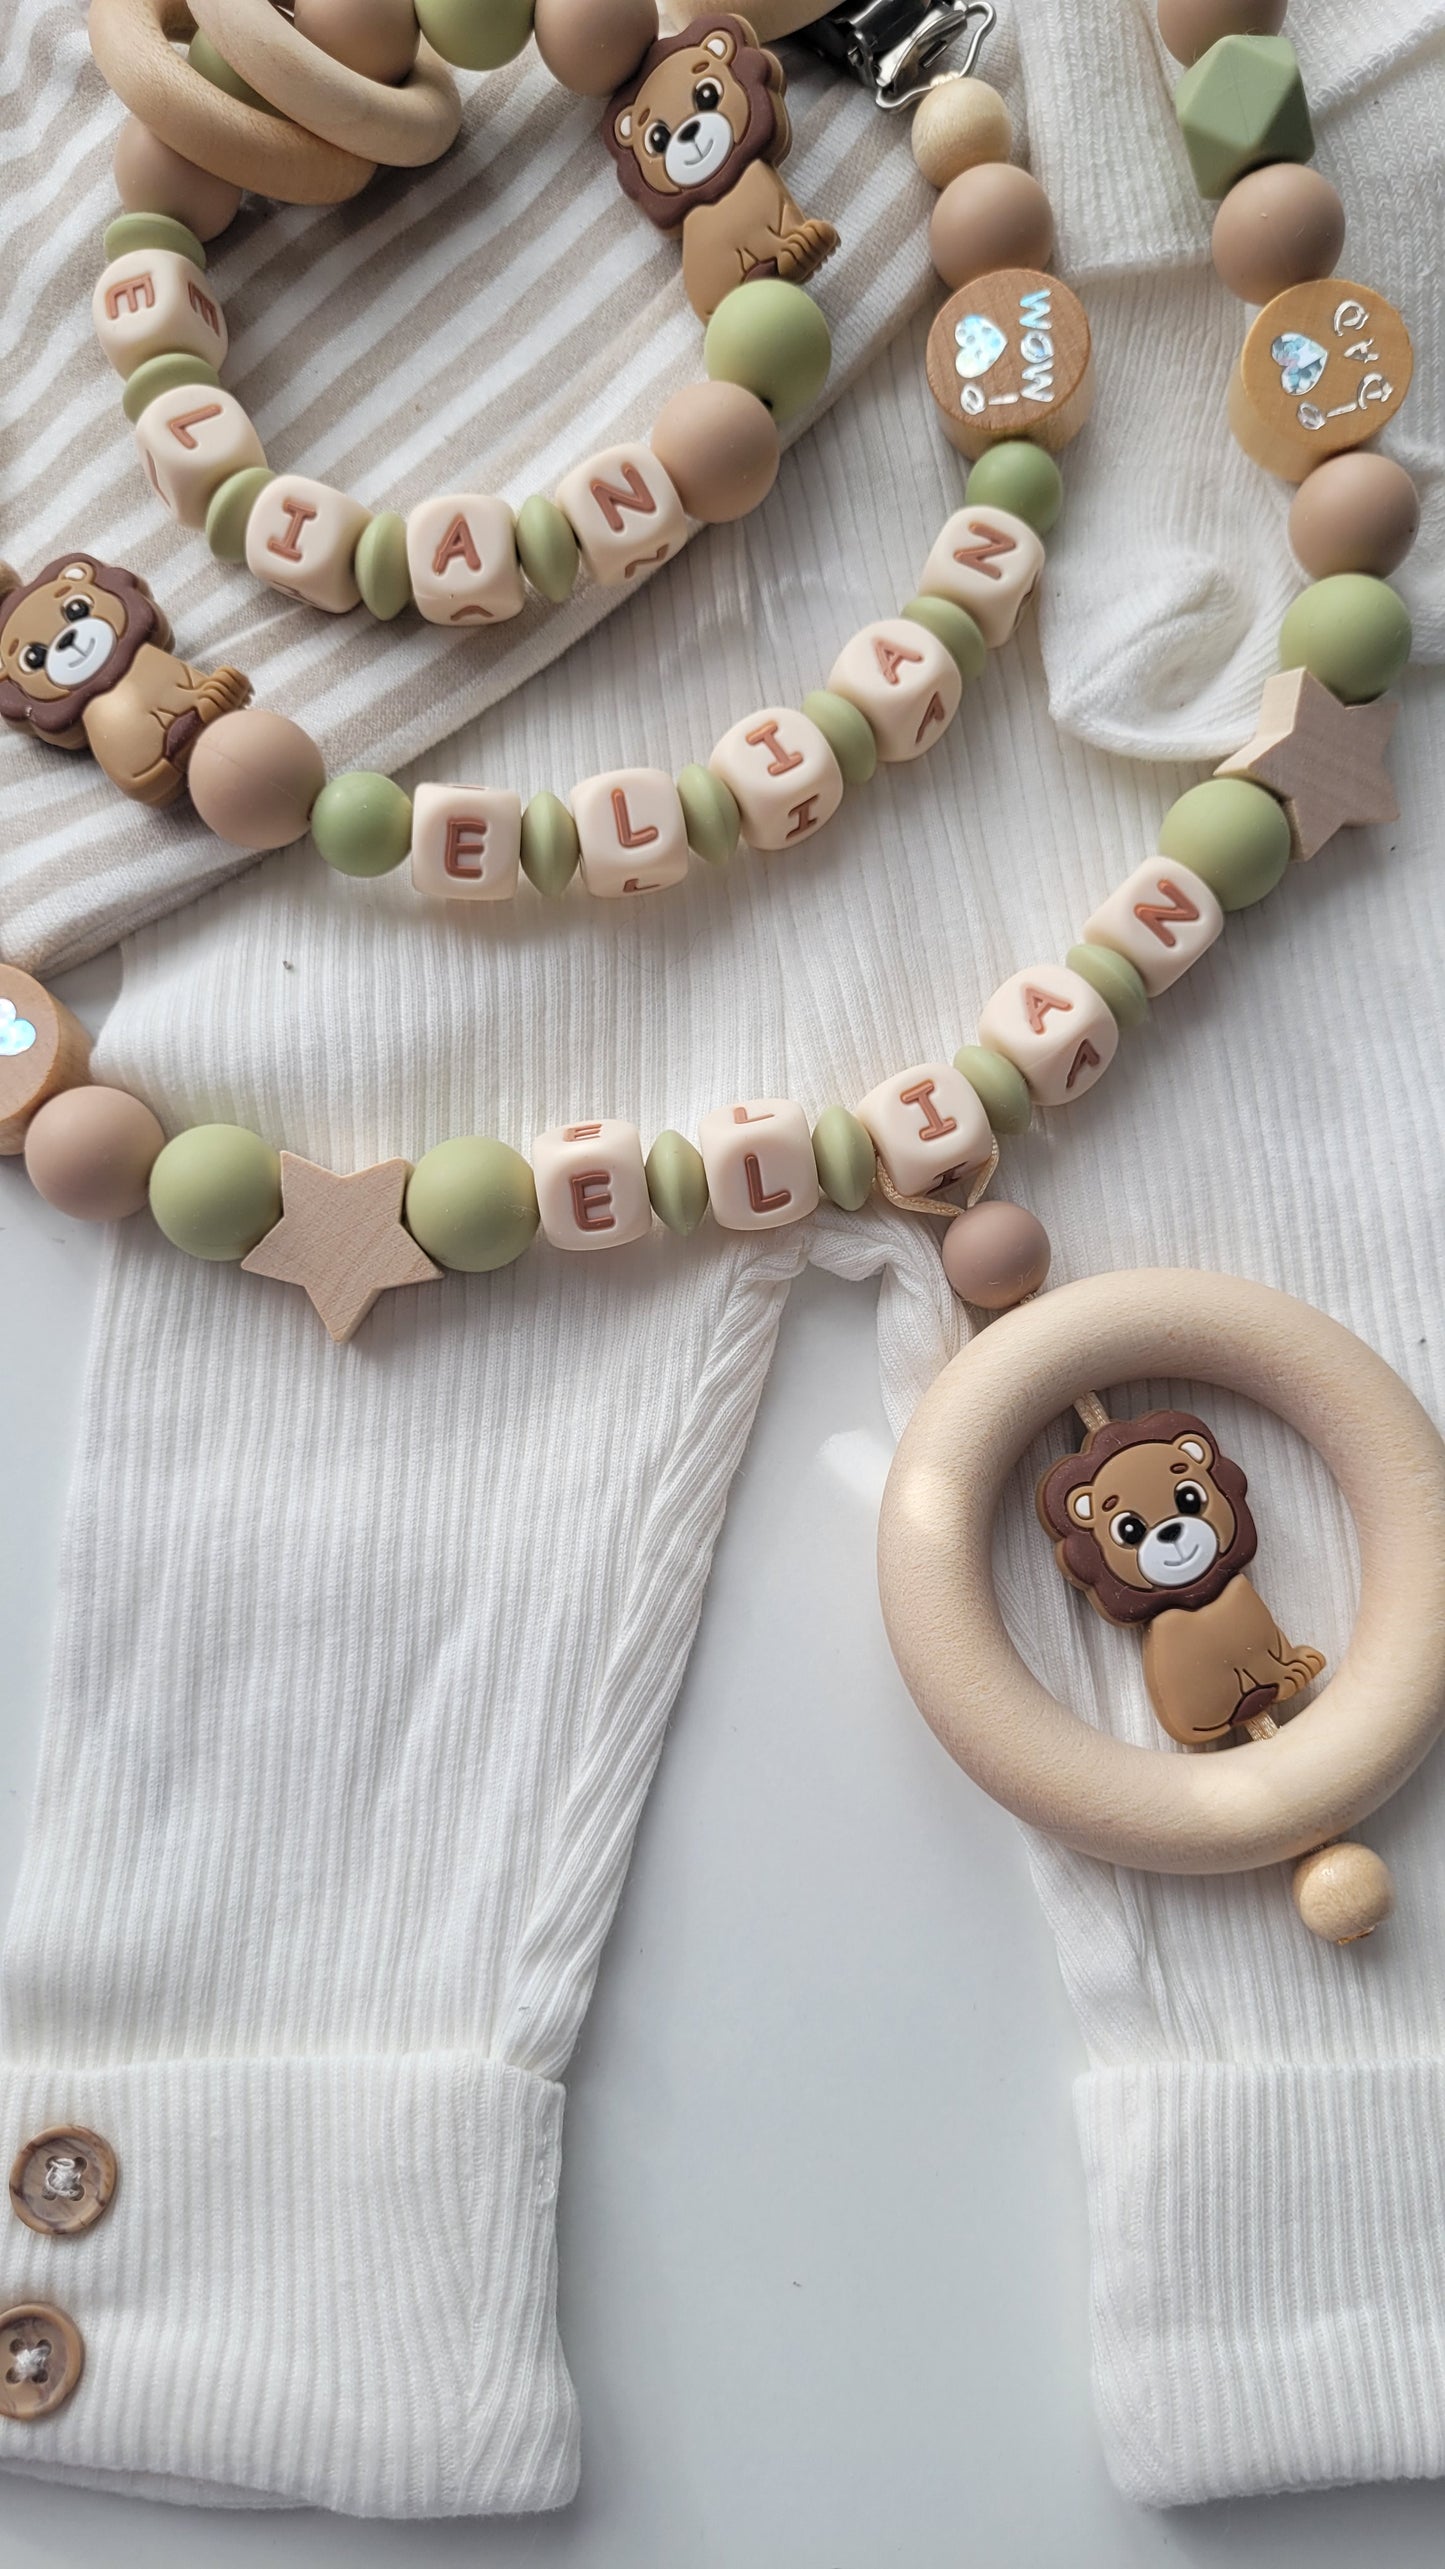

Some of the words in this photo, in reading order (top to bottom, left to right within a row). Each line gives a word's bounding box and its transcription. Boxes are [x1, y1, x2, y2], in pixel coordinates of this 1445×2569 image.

[105, 274, 657, 579] ELIAN
[1019, 289, 1055, 404] MOM
[1333, 299, 1394, 411] DAD
[444, 521, 1017, 879] ELIAN
[568, 878, 1200, 1232] ELIAN
